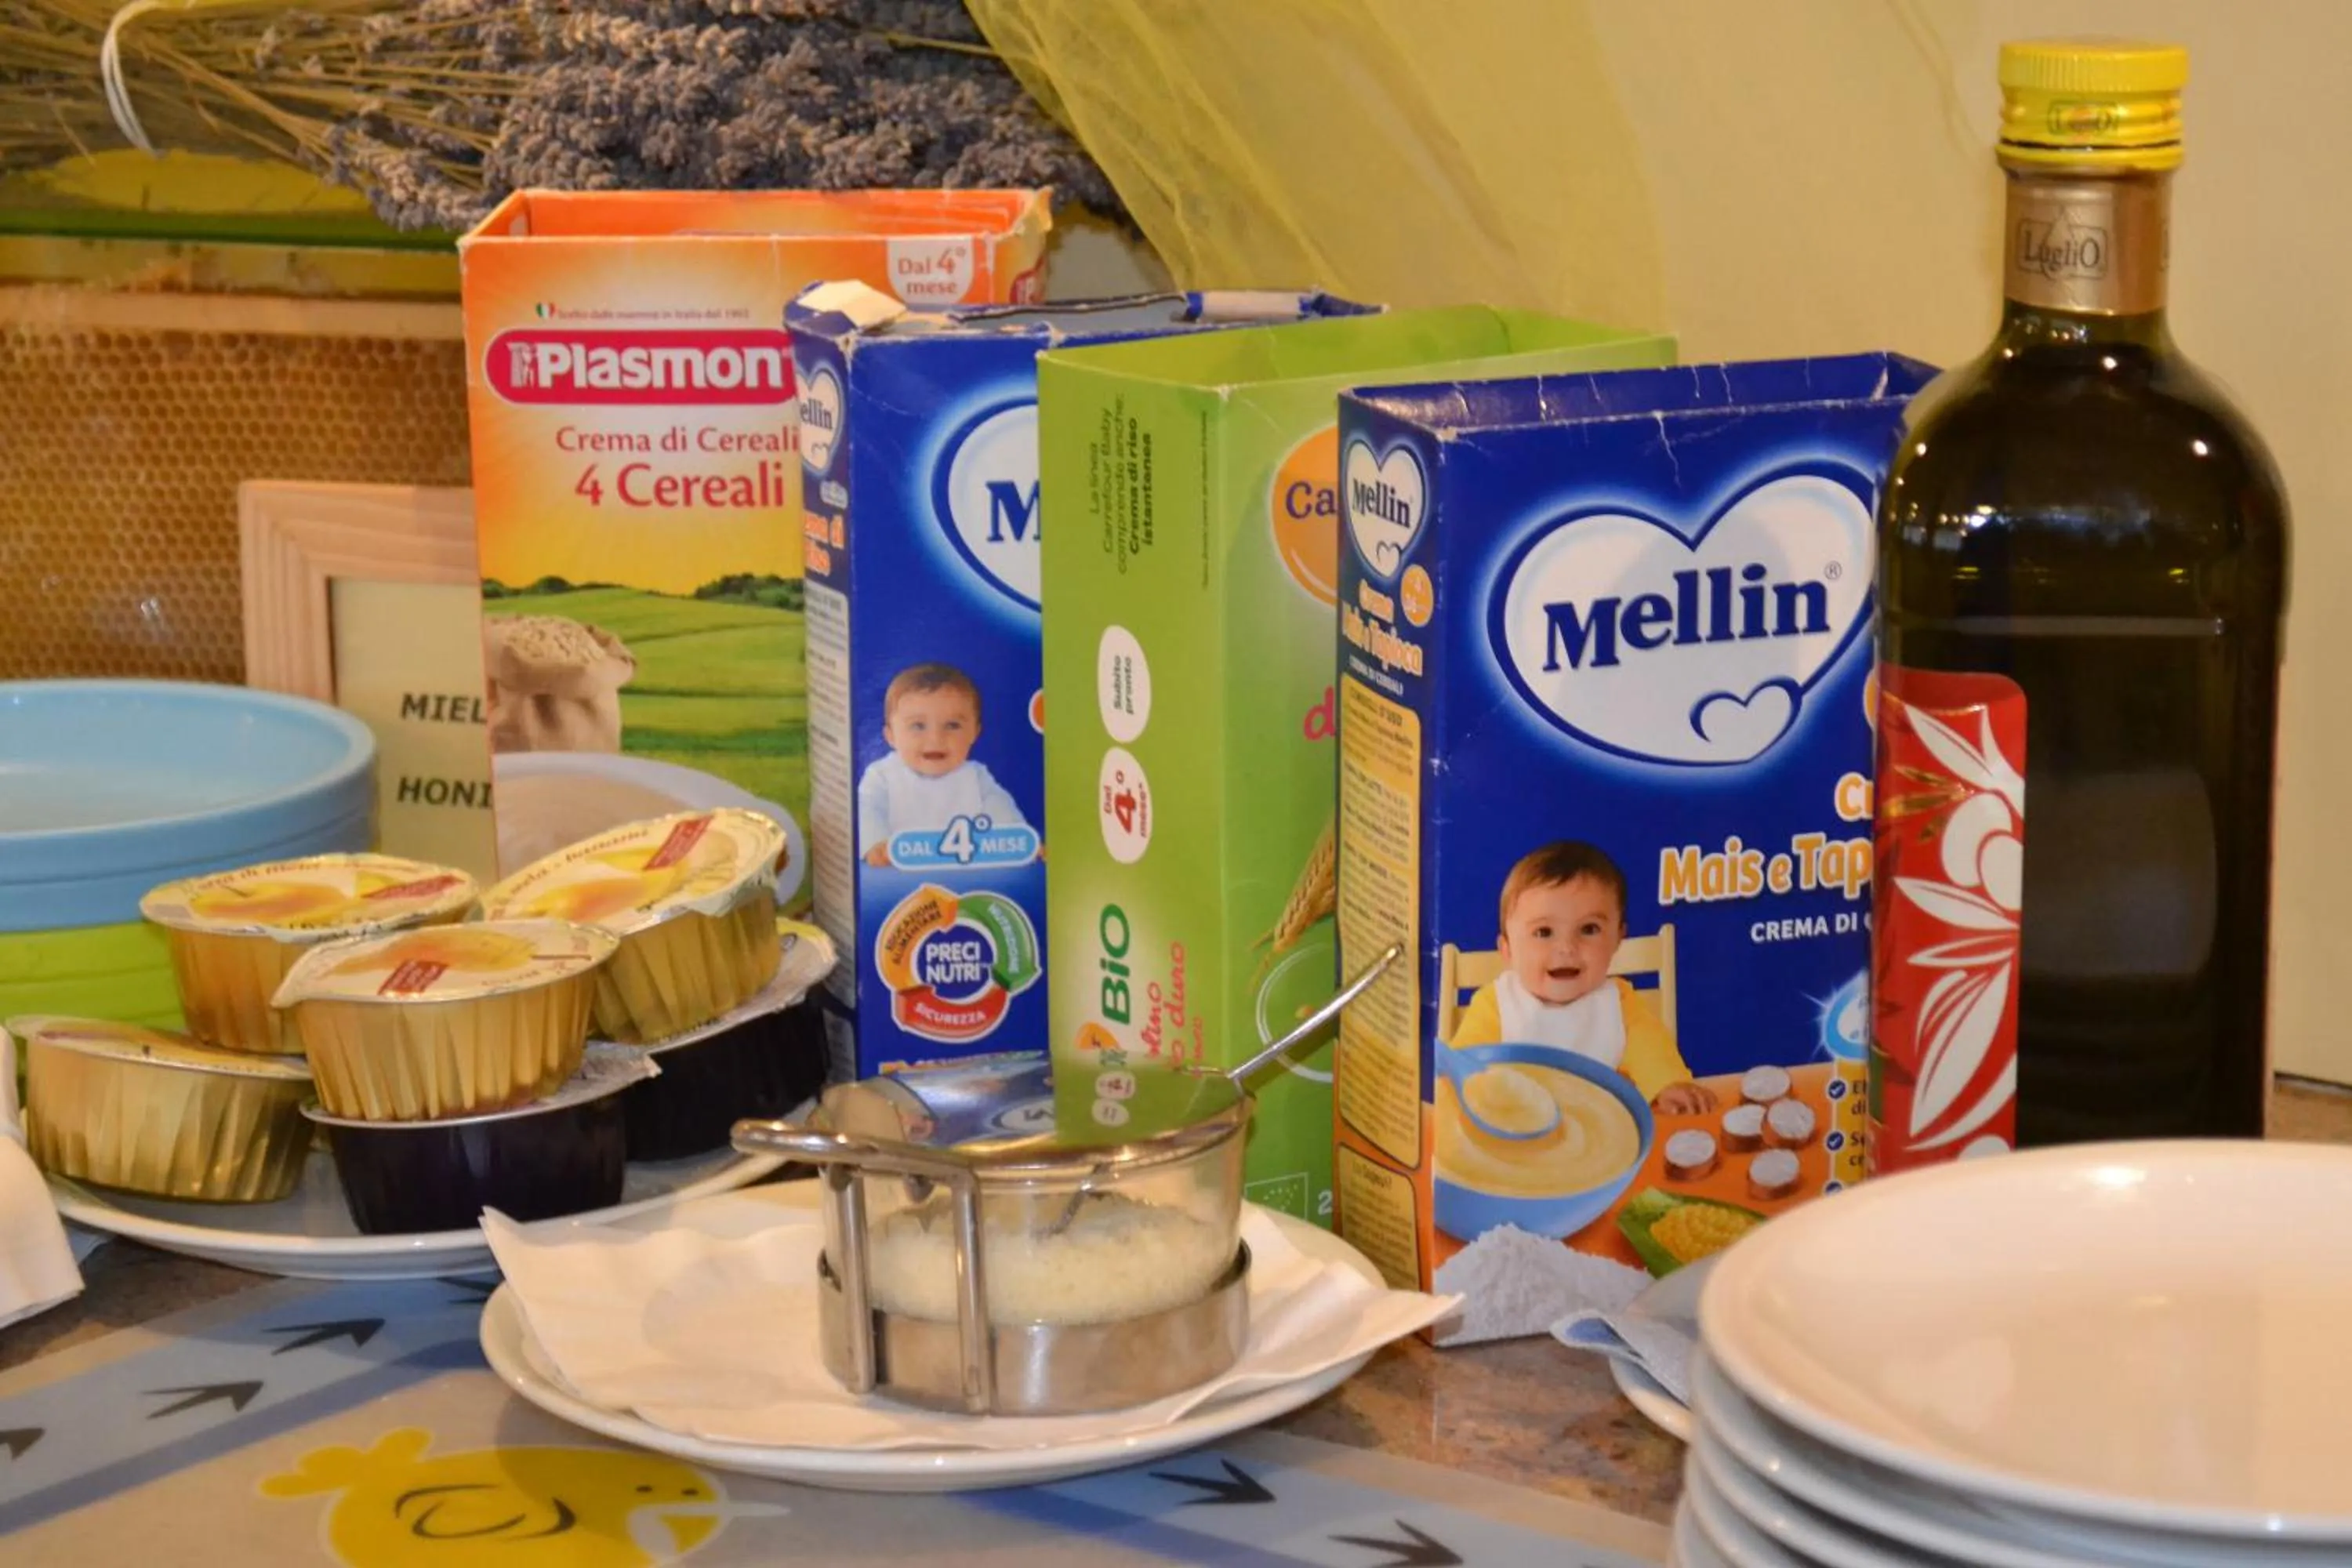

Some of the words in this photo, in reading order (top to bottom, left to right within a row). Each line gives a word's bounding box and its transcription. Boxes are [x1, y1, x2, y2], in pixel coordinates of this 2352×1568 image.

[898, 257, 931, 274] Dal
[906, 281, 957, 294] mese
[536, 342, 783, 388] Plasmon
[800, 397, 833, 430] ellin
[1101, 408, 1113, 456] Baby
[556, 426, 652, 452] Crema
[660, 426, 688, 452] di
[696, 425, 800, 452] Cereali
[1128, 418, 1138, 459] riso
[575, 463, 604, 506] 4
[617, 460, 784, 508] Cereali
[1127, 462, 1138, 483] di
[985, 480, 1041, 543] M
[1102, 461, 1113, 554] Carrefour
[1285, 481, 1337, 520] Ca
[1352, 477, 1411, 529] Mellin
[1129, 486, 1139, 555] Crema
[1542, 562, 1831, 673] Mellin
[400, 692, 488, 724] MIEL
[1303, 684, 1336, 742] d
[397, 776, 493, 810] HONI
[1103, 785, 1112, 815] Dal
[897, 837, 935, 857] DAL
[979, 834, 1028, 855] MESE
[1658, 836, 1765, 906] Mais
[1767, 853, 1793, 894] e
[1791, 831, 1874, 900] Tap
[1750, 915, 1829, 943] CREMA
[1835, 912, 1858, 934] DI
[925, 942, 981, 962] PRECI
[1100, 903, 1131, 1026] BiO
[925, 961, 981, 984] NUTRI
[1163, 941, 1185, 1029] duro
[913, 1002, 987, 1025] SICUREZZA
